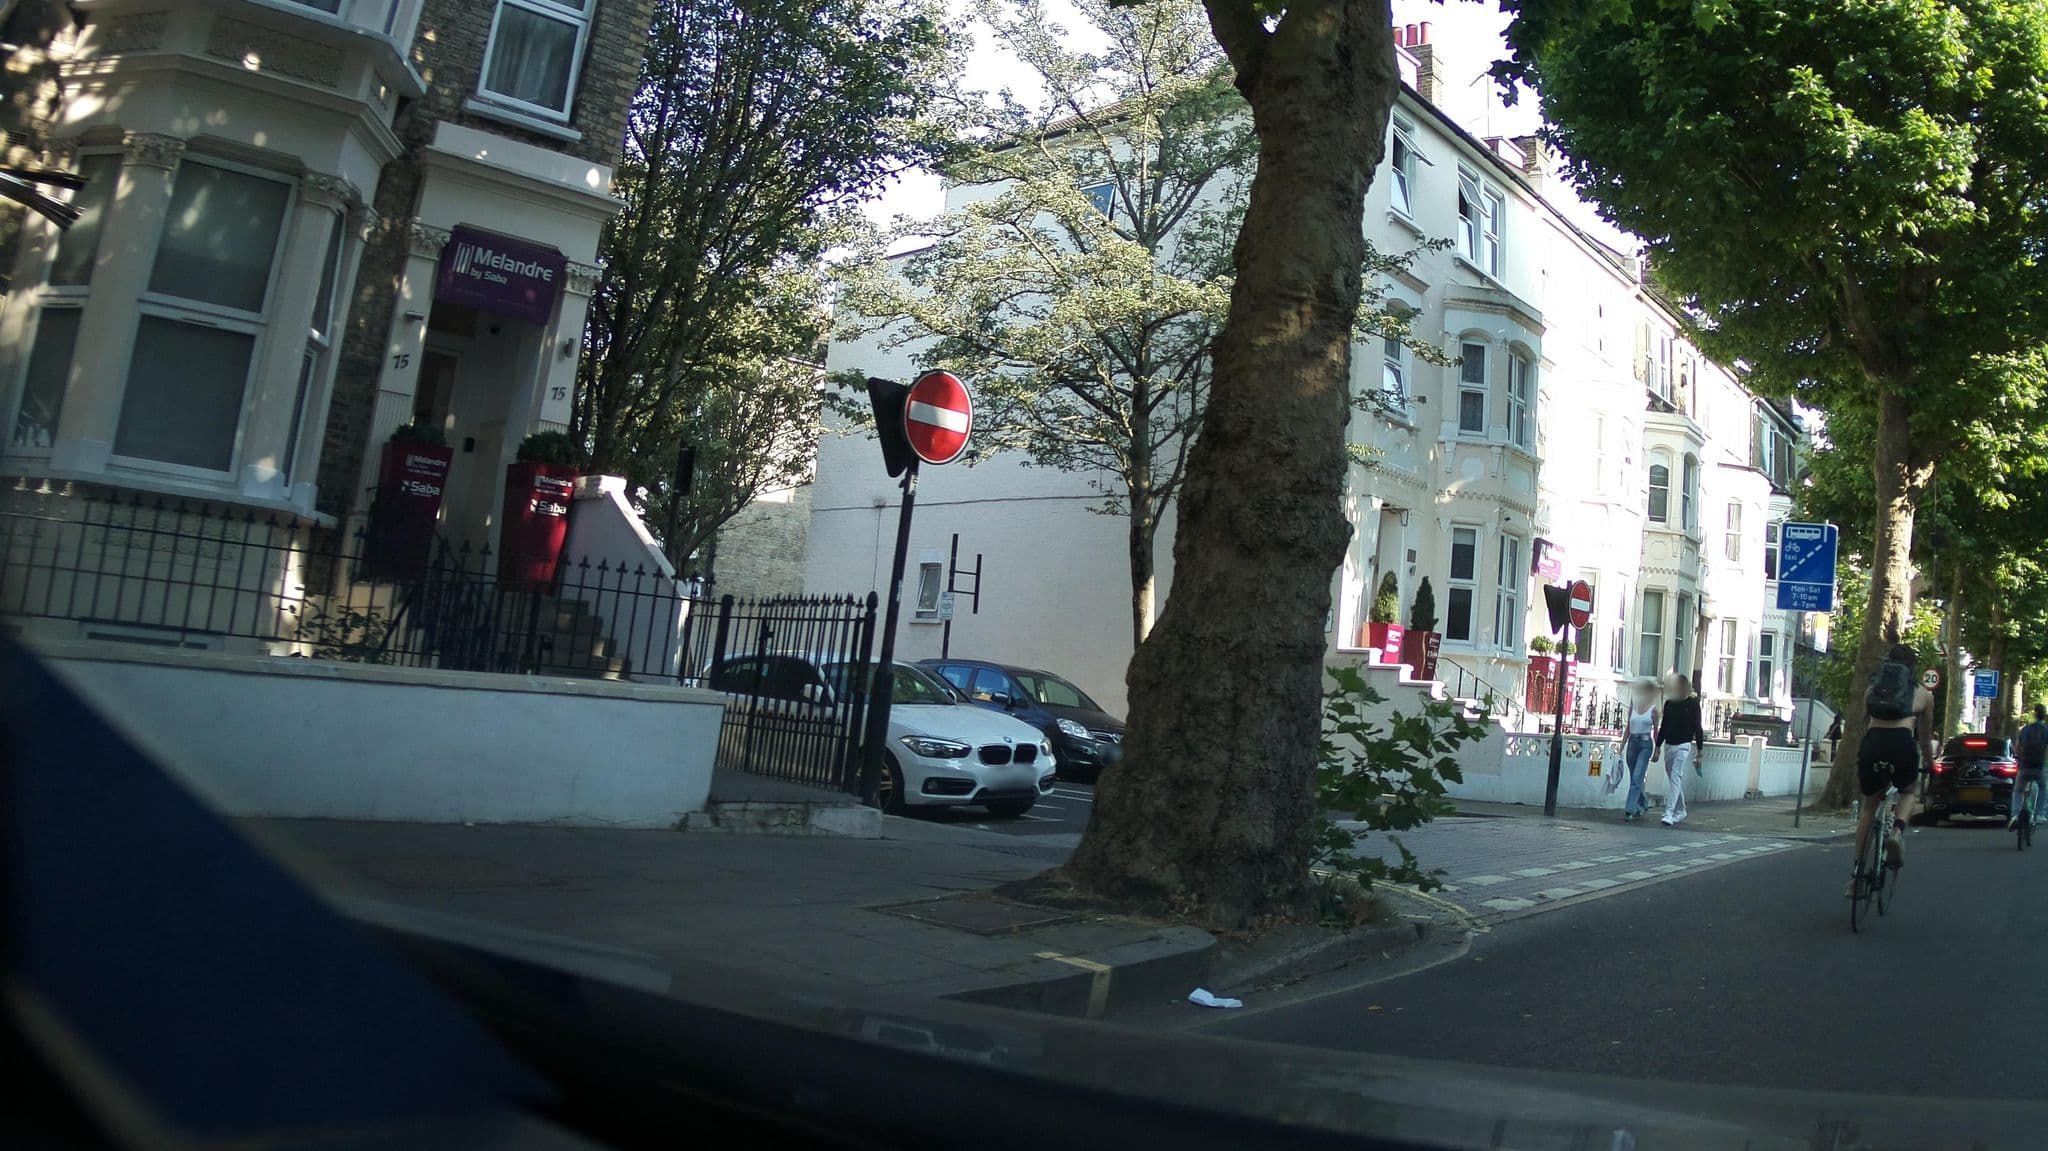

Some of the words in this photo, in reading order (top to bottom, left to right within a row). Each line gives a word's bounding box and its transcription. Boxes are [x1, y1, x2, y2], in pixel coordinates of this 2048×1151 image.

[474, 247, 553, 281] Melandre
[470, 267, 482, 280] by
[484, 271, 508, 285] Saba
[393, 354, 410, 369] 75
[551, 387, 567, 400] 75
[410, 481, 440, 496] Saba
[538, 500, 567, 514] Saba
[1924, 674, 1938, 684] 20
